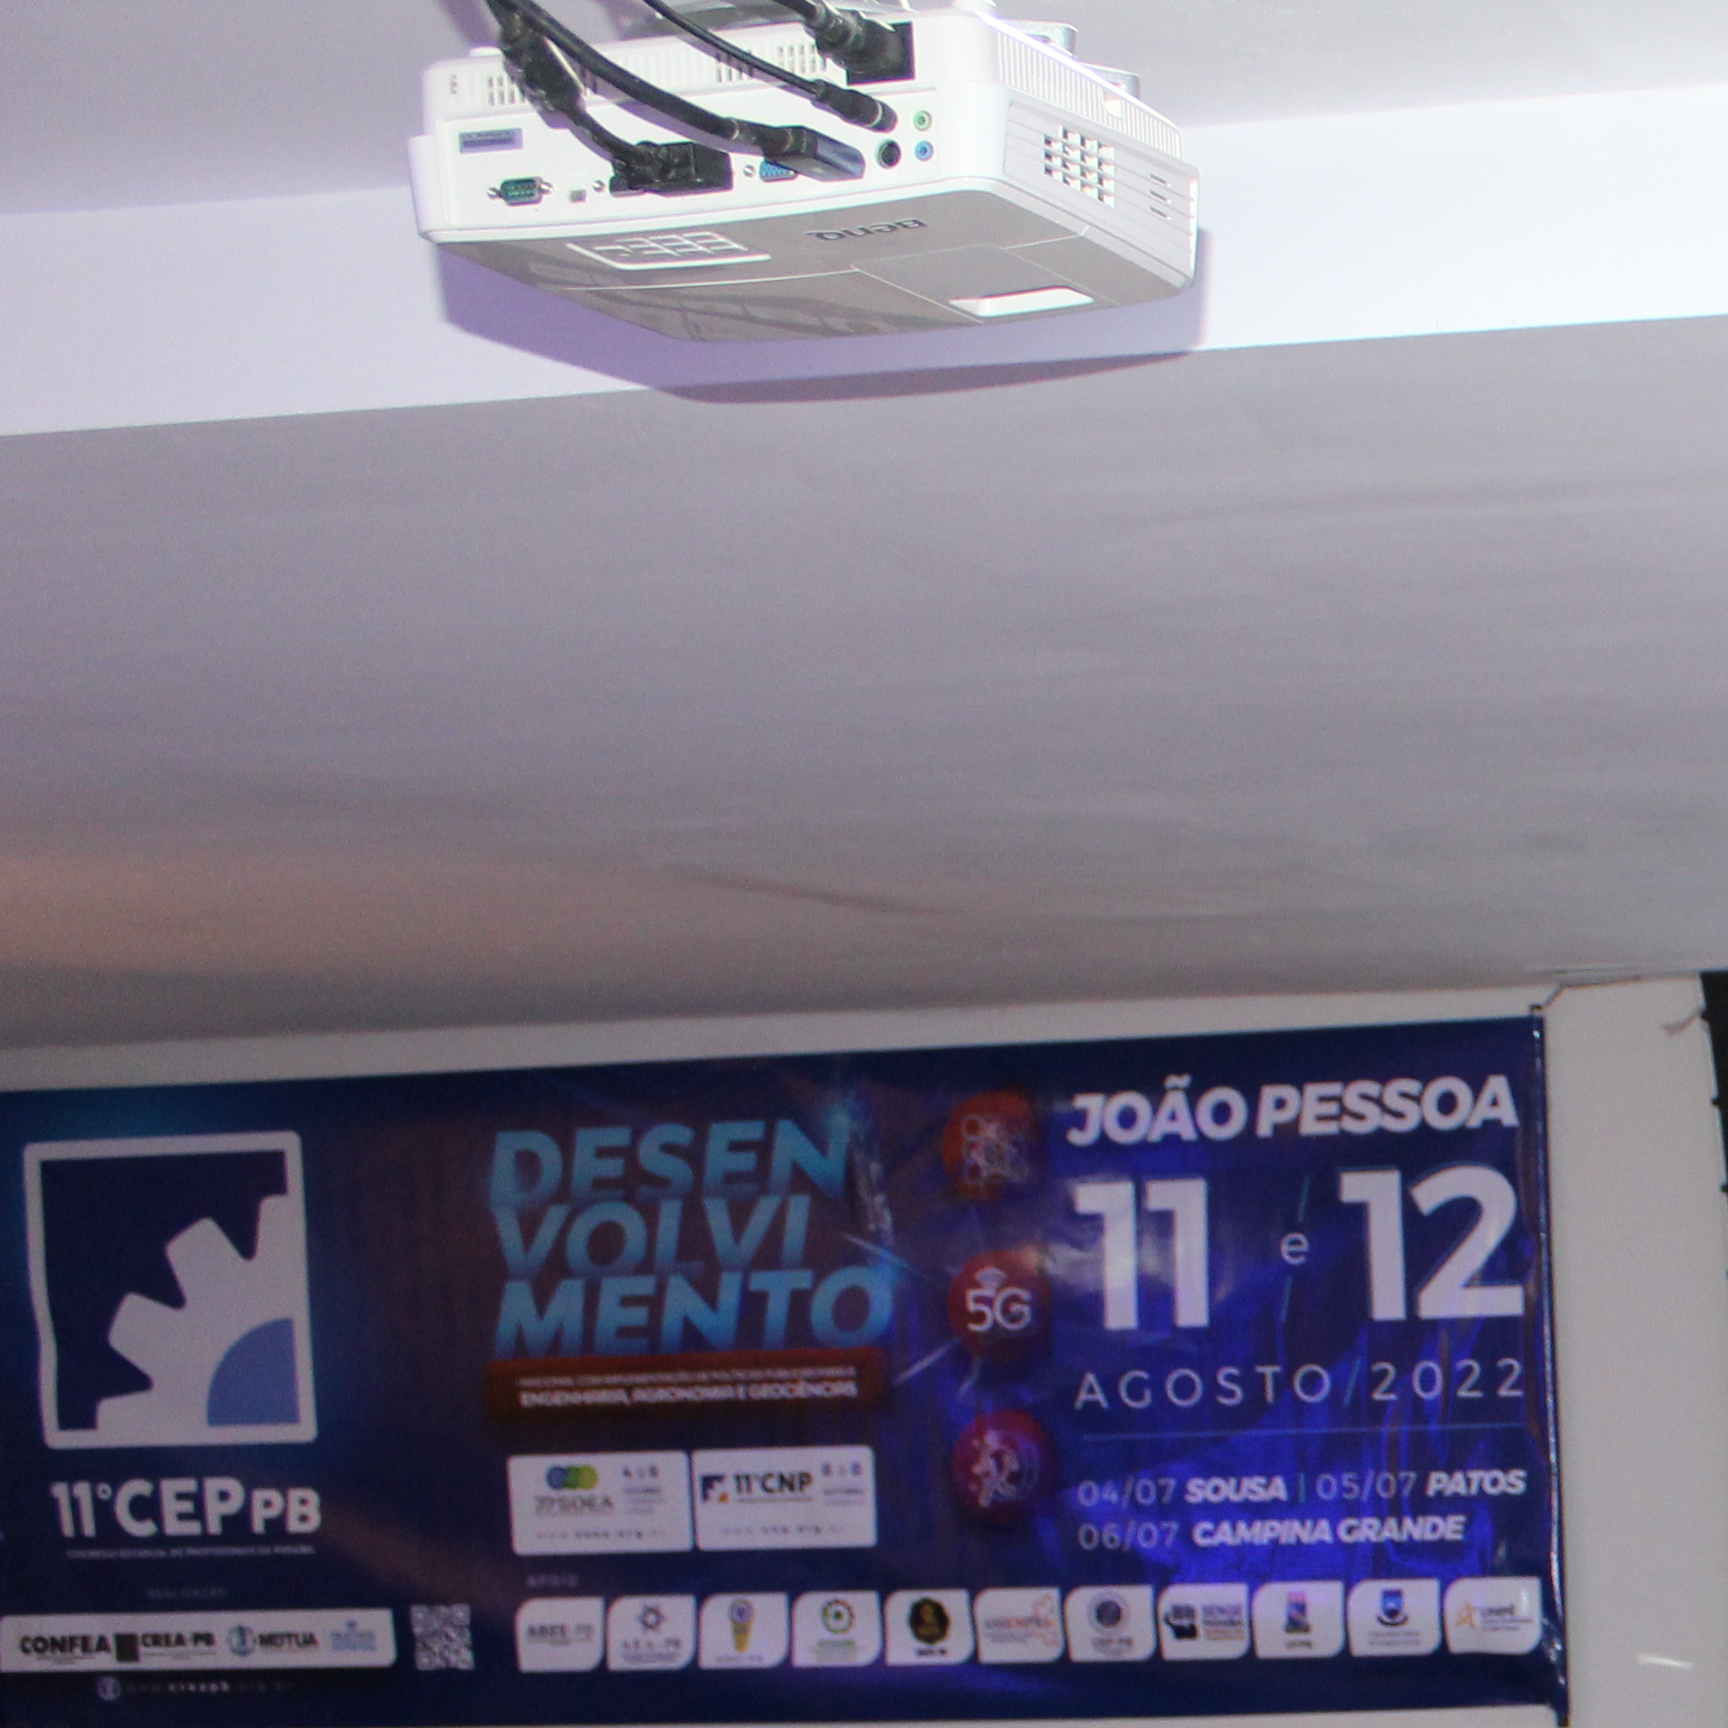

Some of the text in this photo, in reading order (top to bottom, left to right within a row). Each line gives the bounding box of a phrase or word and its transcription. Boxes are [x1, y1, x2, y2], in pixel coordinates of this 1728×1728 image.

[1067, 1074, 1519, 1146] JOÃO PESSOA
[491, 1119, 850, 1205] DESEN
[494, 1194, 811, 1278] VOLVI
[1075, 1164, 1525, 1330] 11 e 12
[495, 1265, 896, 1358] MENTO
[966, 1287, 1032, 1334] 5G
[1077, 1469, 1527, 1507] 04/07 SOUSA 05/07 PATOS
[1077, 1515, 1467, 1551] 06/07 CAMPINA GRANDE
[20, 1634, 112, 1654] CONFEA
